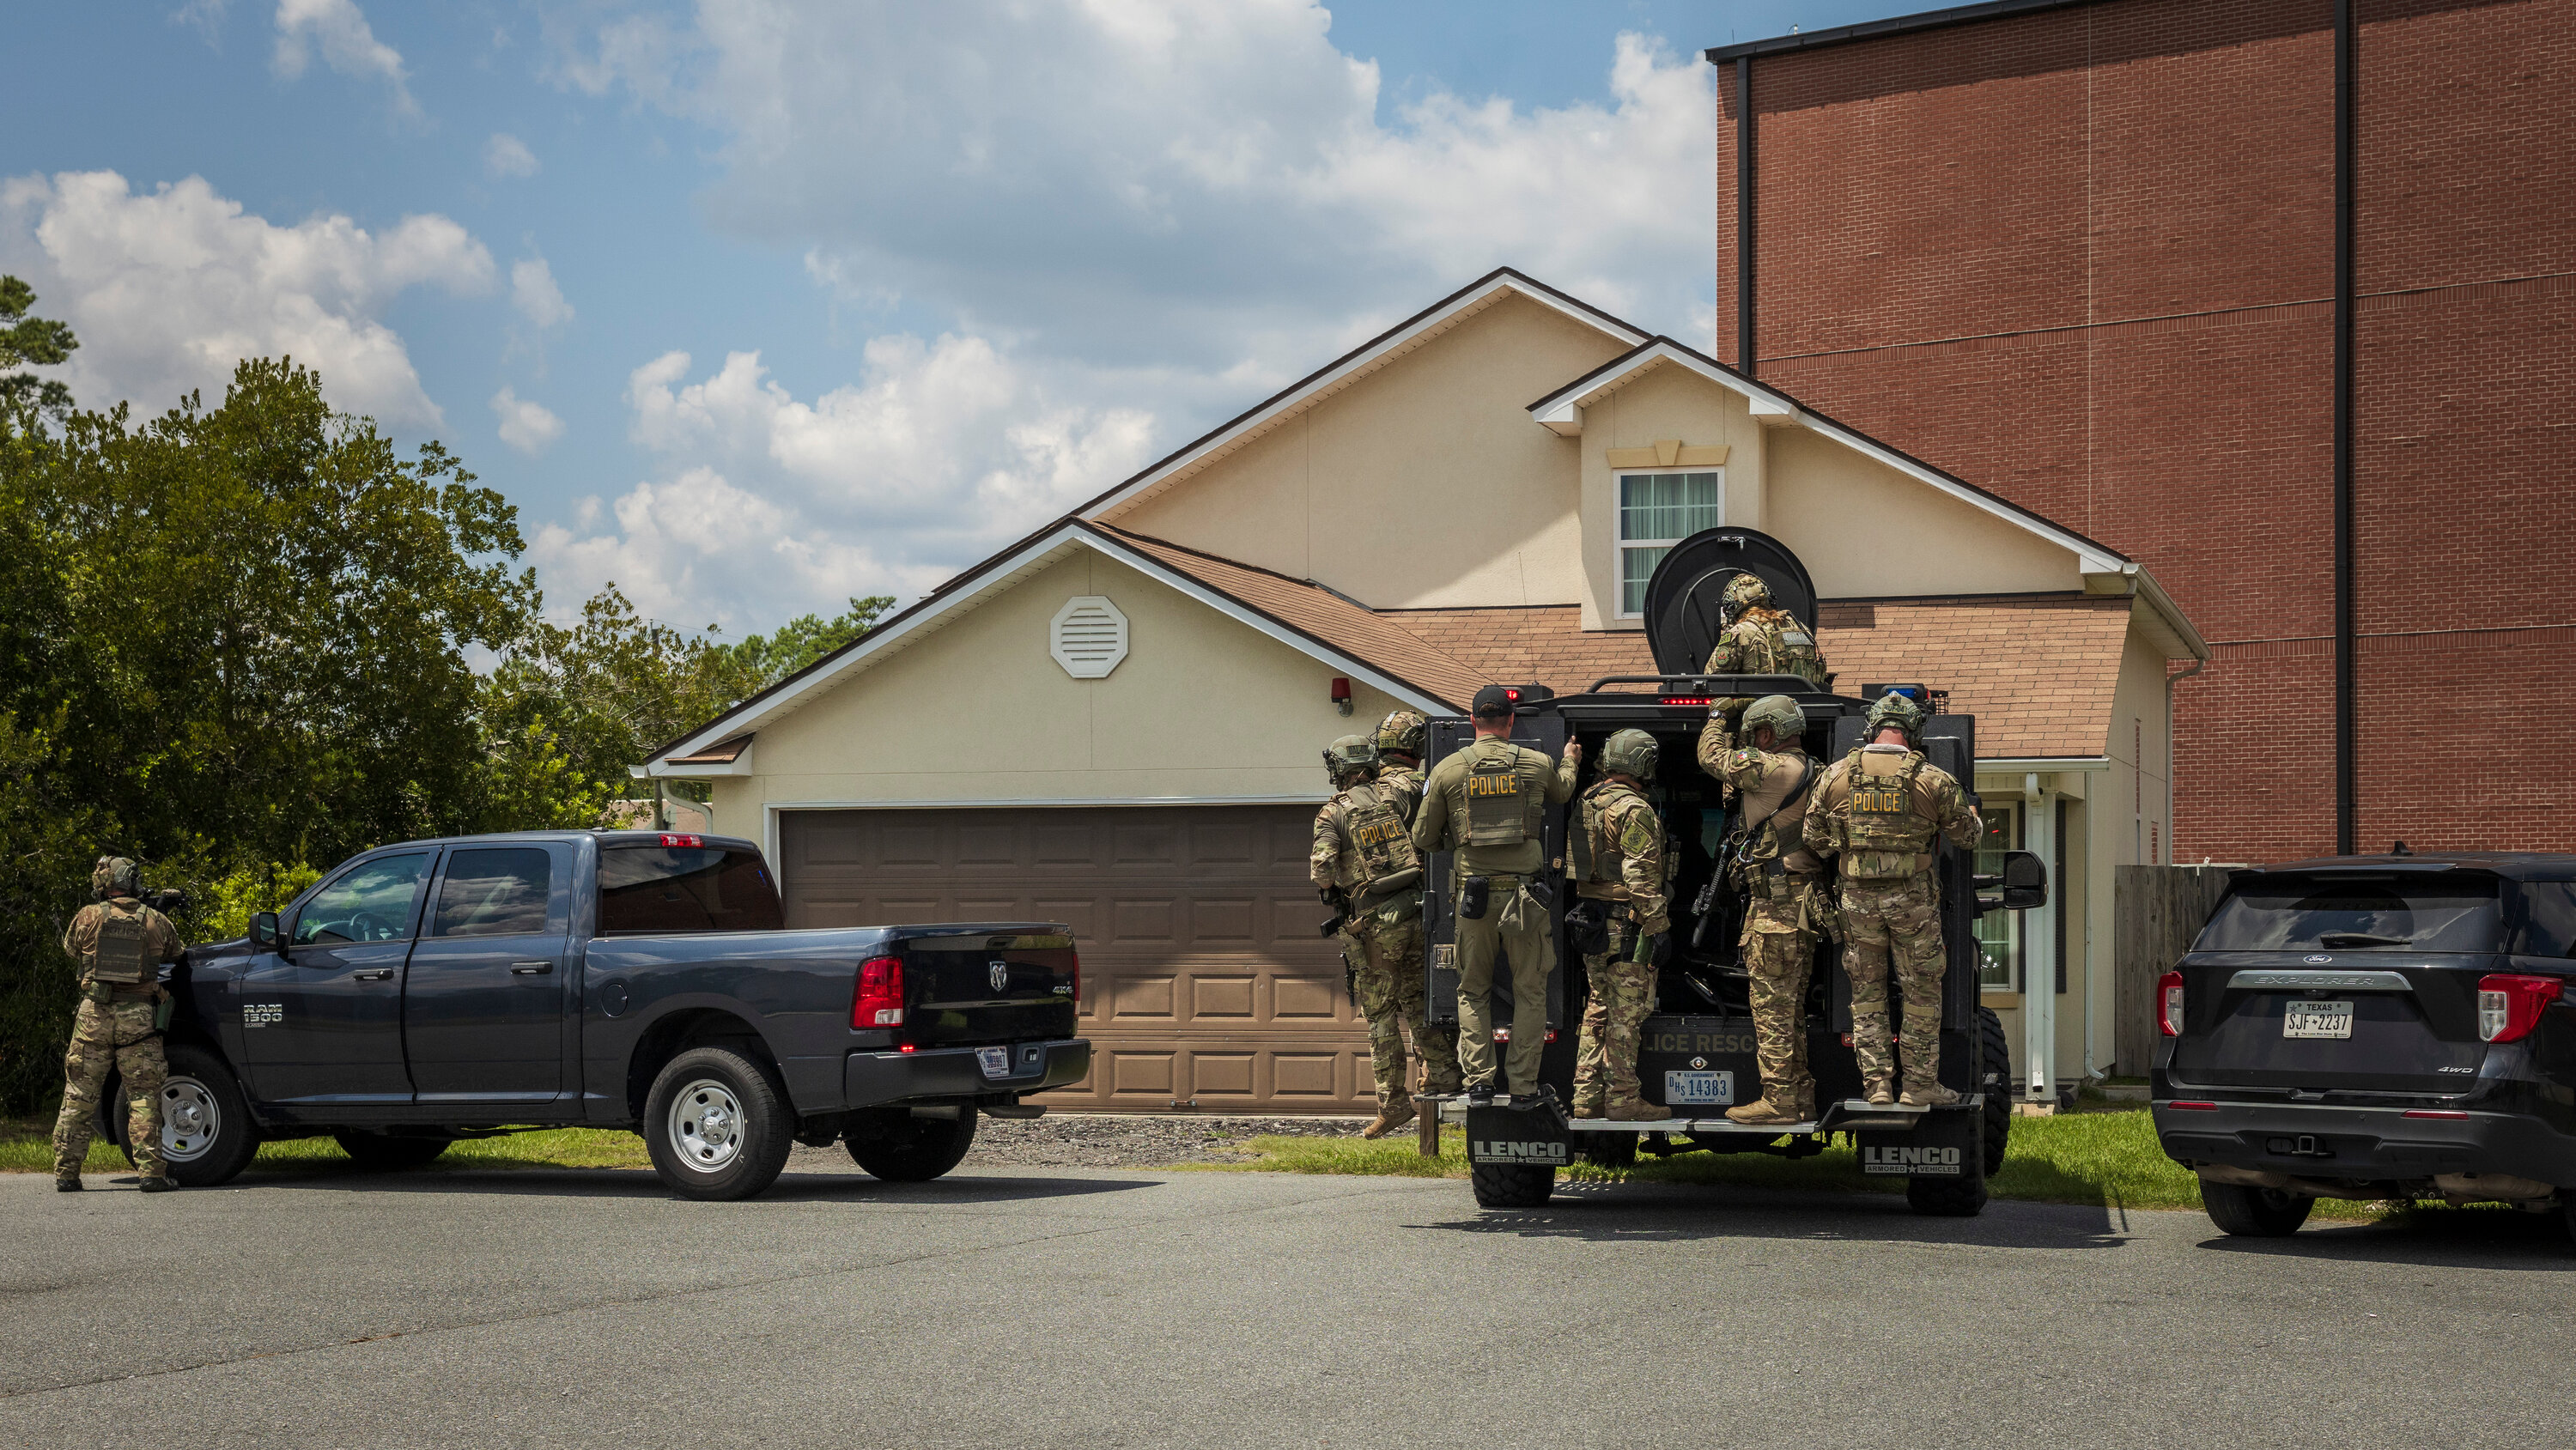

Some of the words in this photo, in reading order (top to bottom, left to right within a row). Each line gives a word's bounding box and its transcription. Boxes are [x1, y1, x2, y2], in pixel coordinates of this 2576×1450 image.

[1380, 738, 1395, 747] SRT
[1469, 774, 1517, 796] POLICE
[1854, 792, 1901, 811] POLICE
[1358, 819, 1403, 846] POLICE
[243, 1004, 283, 1013] RAM
[244, 1013, 283, 1022] 1500
[2288, 1014, 2311, 1029] SJF
[2318, 1014, 2348, 1030] 2237
[1643, 1034, 1689, 1052] LICE
[1696, 1034, 1755, 1053] RESC
[1689, 1079, 1726, 1096] 14383
[1473, 1141, 1566, 1157] LENCO
[1864, 1146, 1959, 1164] LENCO
